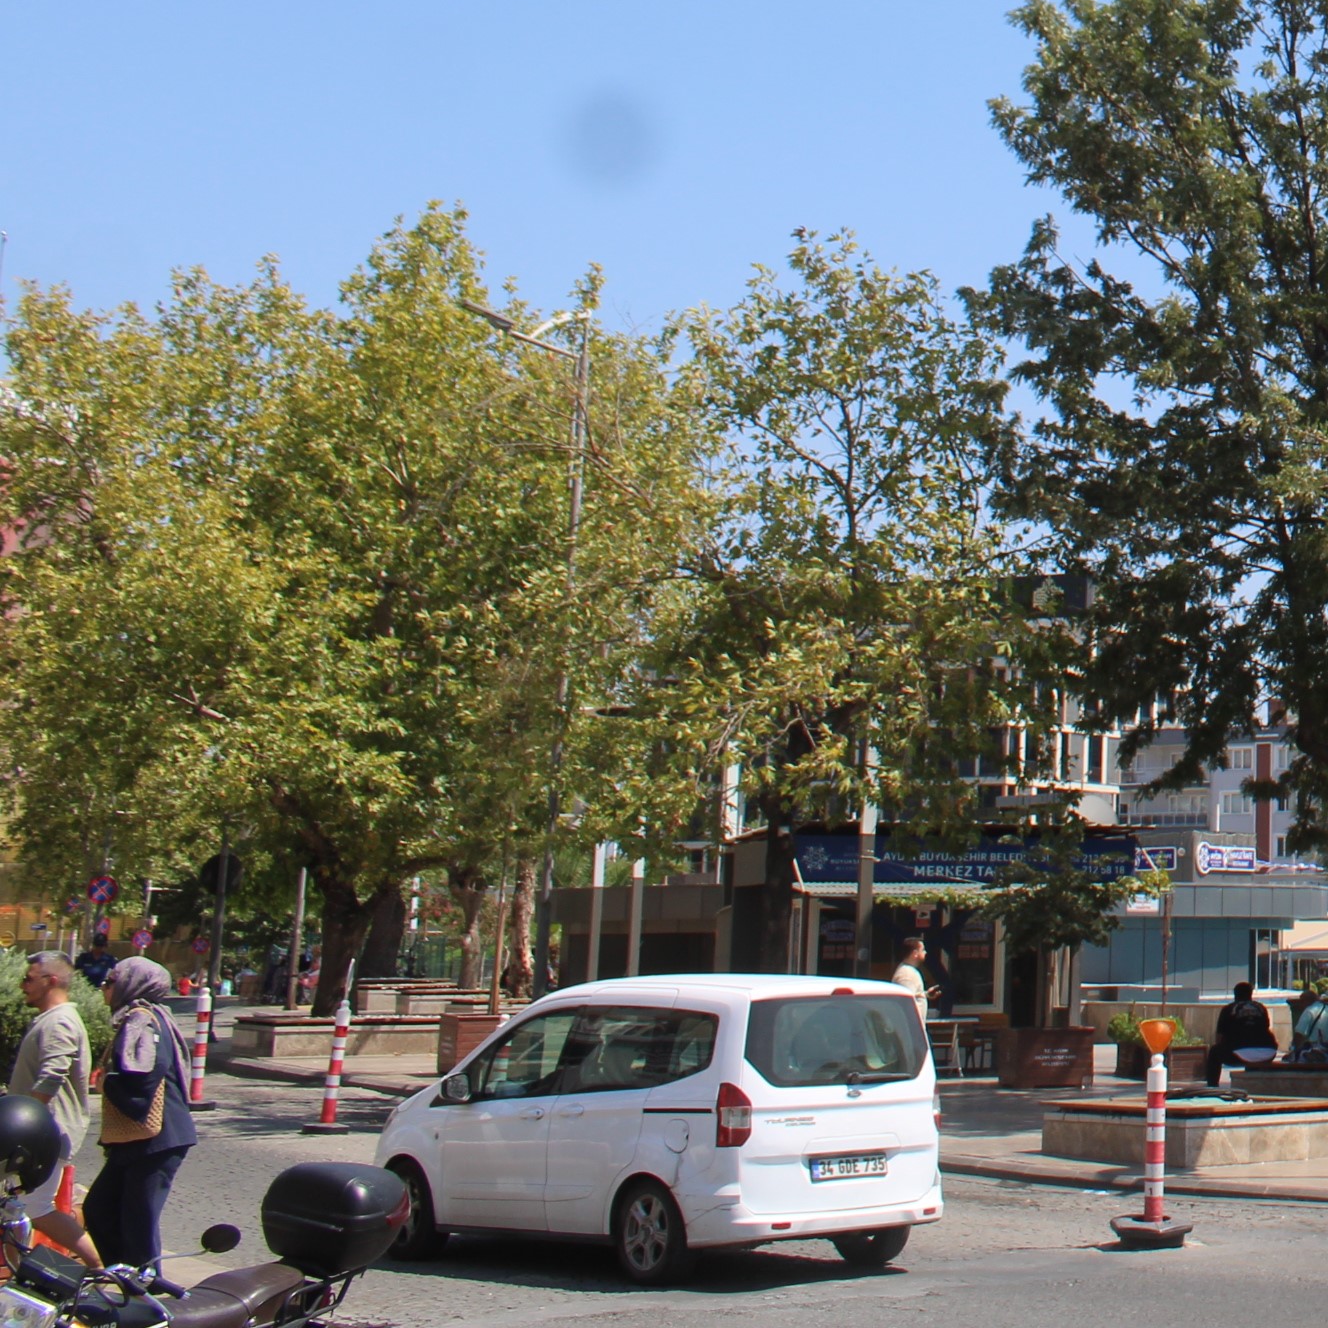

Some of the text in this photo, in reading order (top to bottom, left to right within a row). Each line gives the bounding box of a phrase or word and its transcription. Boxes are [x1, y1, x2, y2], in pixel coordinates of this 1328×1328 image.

[914, 865, 973, 877] MERKEZ
[819, 1157, 886, 1176] 34 GDE 735
